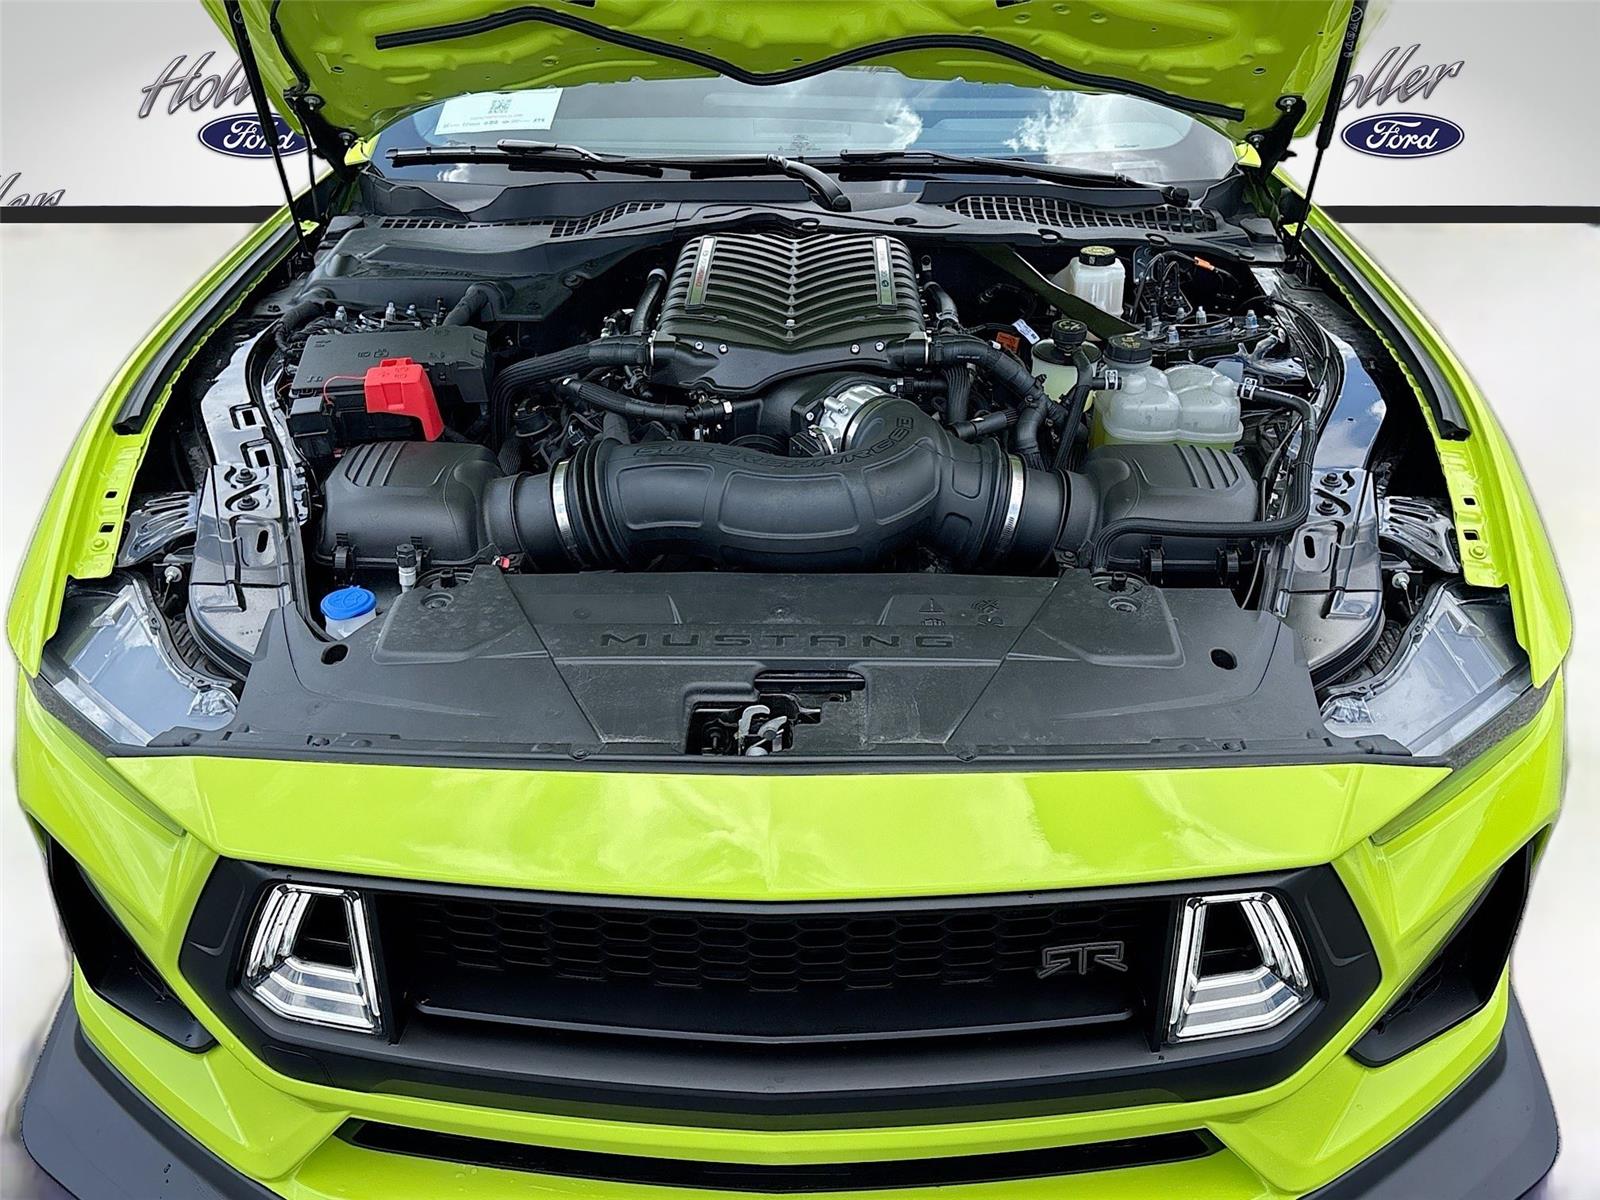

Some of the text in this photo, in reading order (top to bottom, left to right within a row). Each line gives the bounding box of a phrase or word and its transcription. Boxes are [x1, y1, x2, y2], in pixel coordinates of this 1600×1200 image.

[138, 51, 252, 119] Holl
[1339, 43, 1465, 110] oller
[1366, 119, 1440, 150] Ford
[600, 632, 954, 649] MUSTANG
[1036, 940, 1129, 979] RTR
